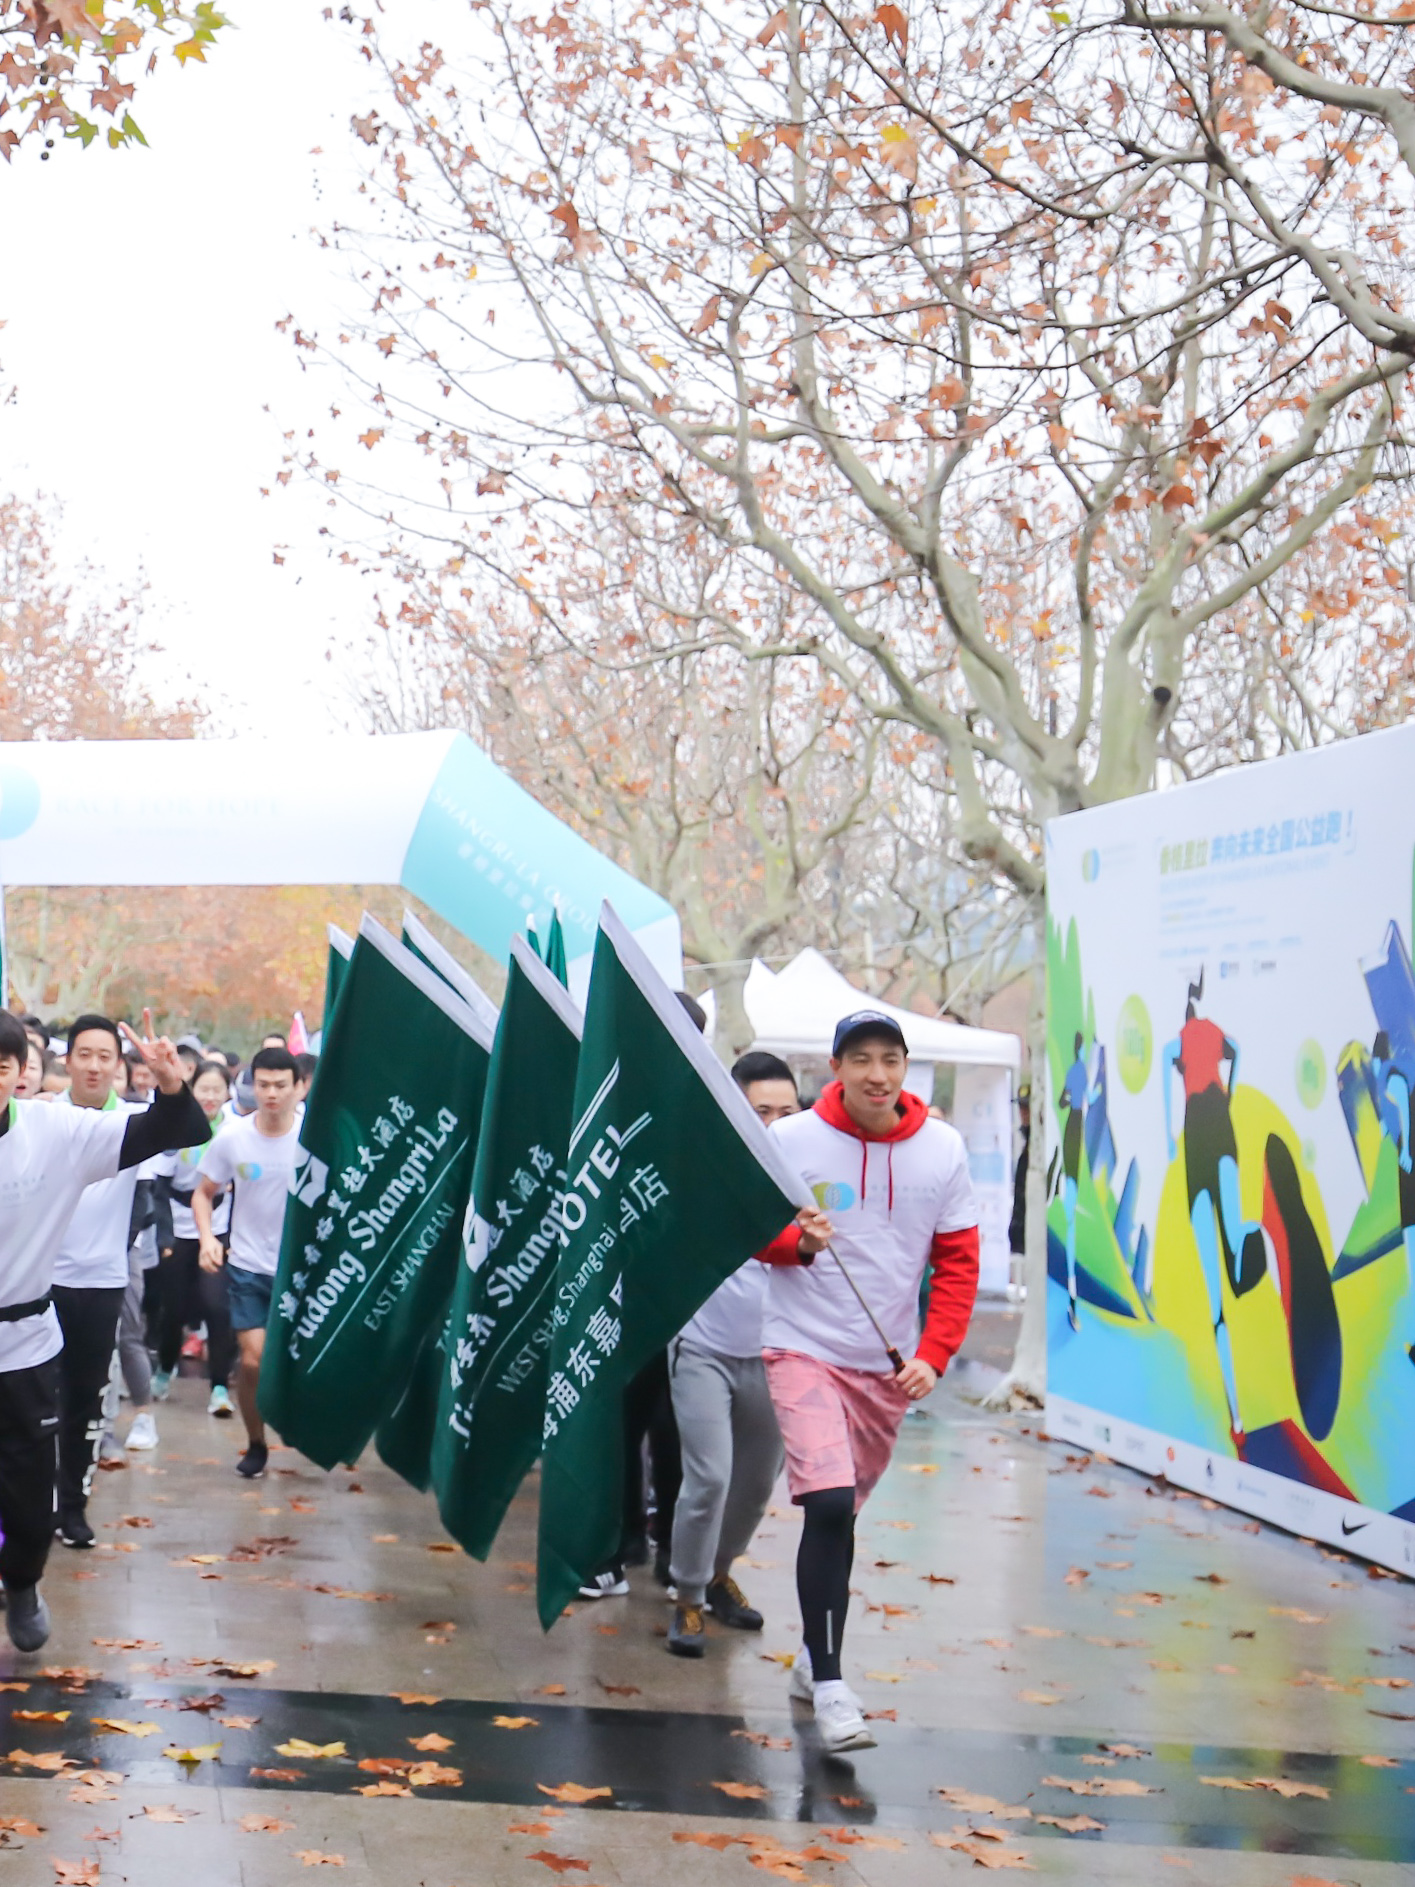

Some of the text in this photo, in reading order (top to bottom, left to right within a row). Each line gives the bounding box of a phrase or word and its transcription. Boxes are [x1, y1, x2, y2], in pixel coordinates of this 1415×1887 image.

[348, 1106, 458, 1250] Shangri-La
[560, 1111, 652, 1247] OTEL
[364, 1202, 456, 1331] EAST SHANGHAI
[559, 1222, 618, 1309] Shanghai
[495, 1341, 540, 1393] WEST
